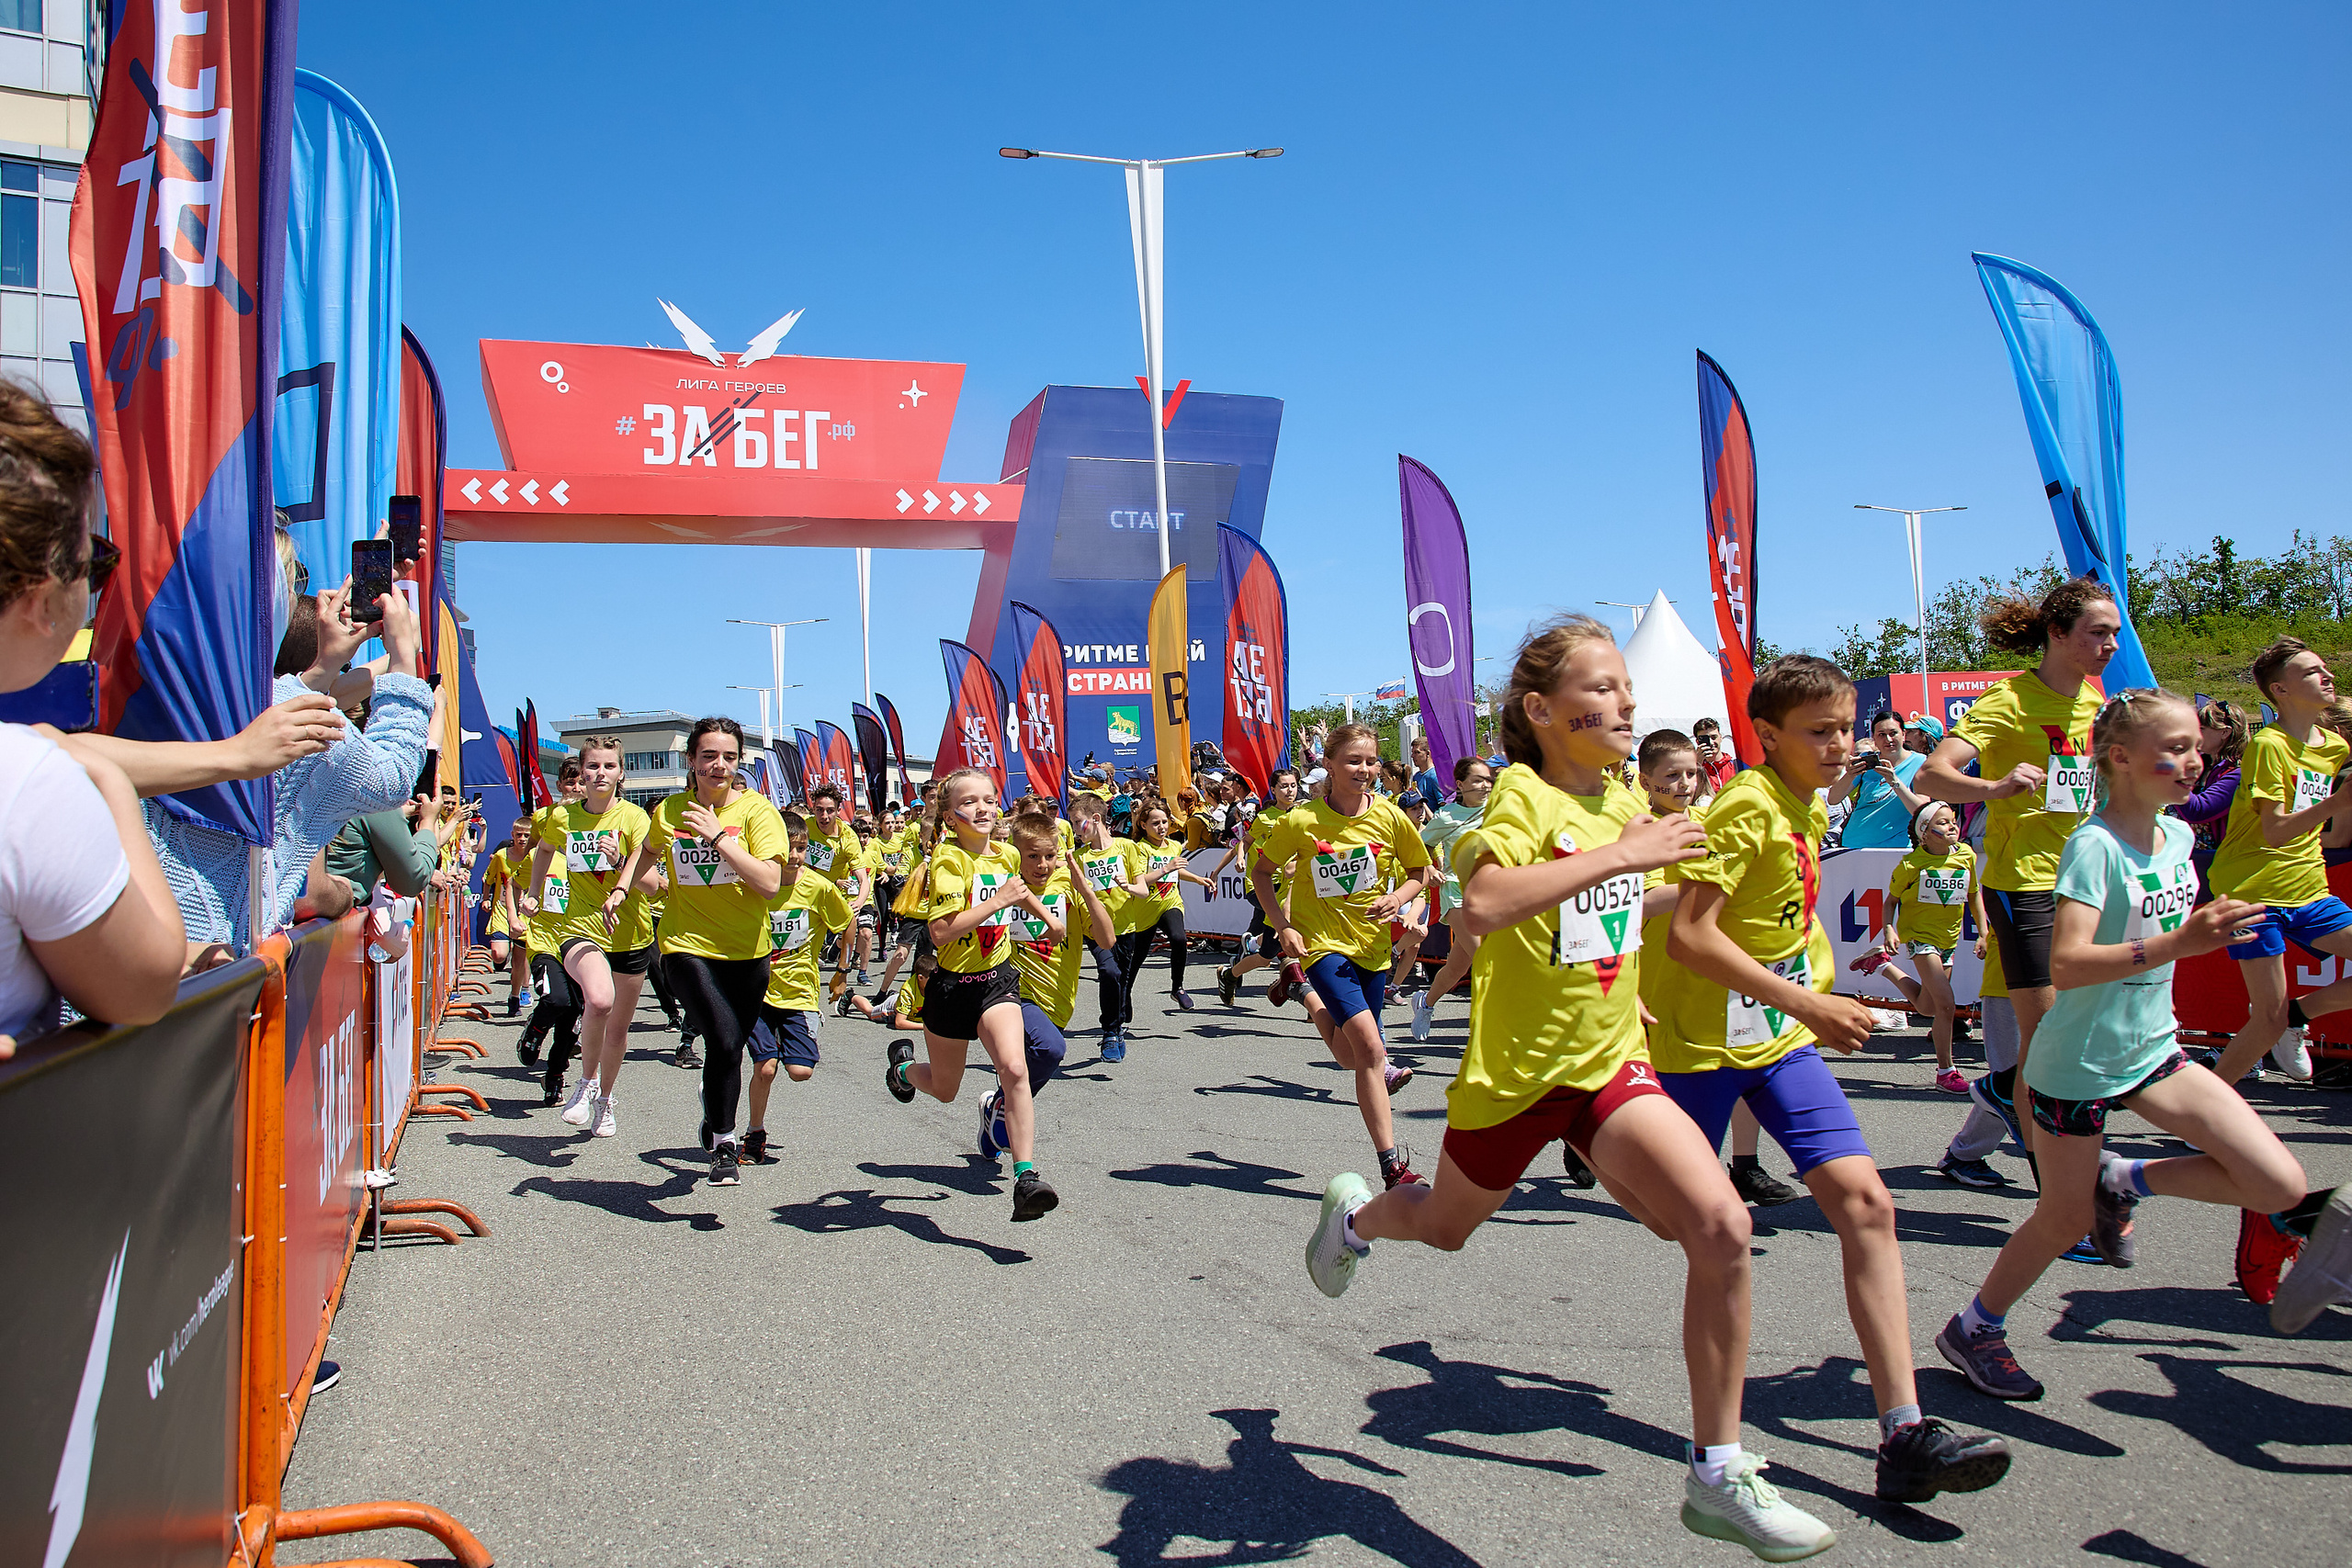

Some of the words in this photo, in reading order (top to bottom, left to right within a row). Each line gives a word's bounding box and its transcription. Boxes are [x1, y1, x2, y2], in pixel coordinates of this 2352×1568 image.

[676, 378, 719, 391] ЛИГА
[725, 381, 786, 394] ГЕРОЕВ
[1110, 511, 1184, 530] СТАТ
[1951, 682, 1985, 691] РИТМЕ
[680, 849, 728, 864] 0028
[1088, 863, 1119, 878] 00361
[1318, 856, 1369, 879] 00467
[1221, 876, 1248, 900] ПС
[1925, 878, 1964, 890] 00586
[1575, 875, 1641, 915] 00524
[2142, 884, 2194, 919] 00296
